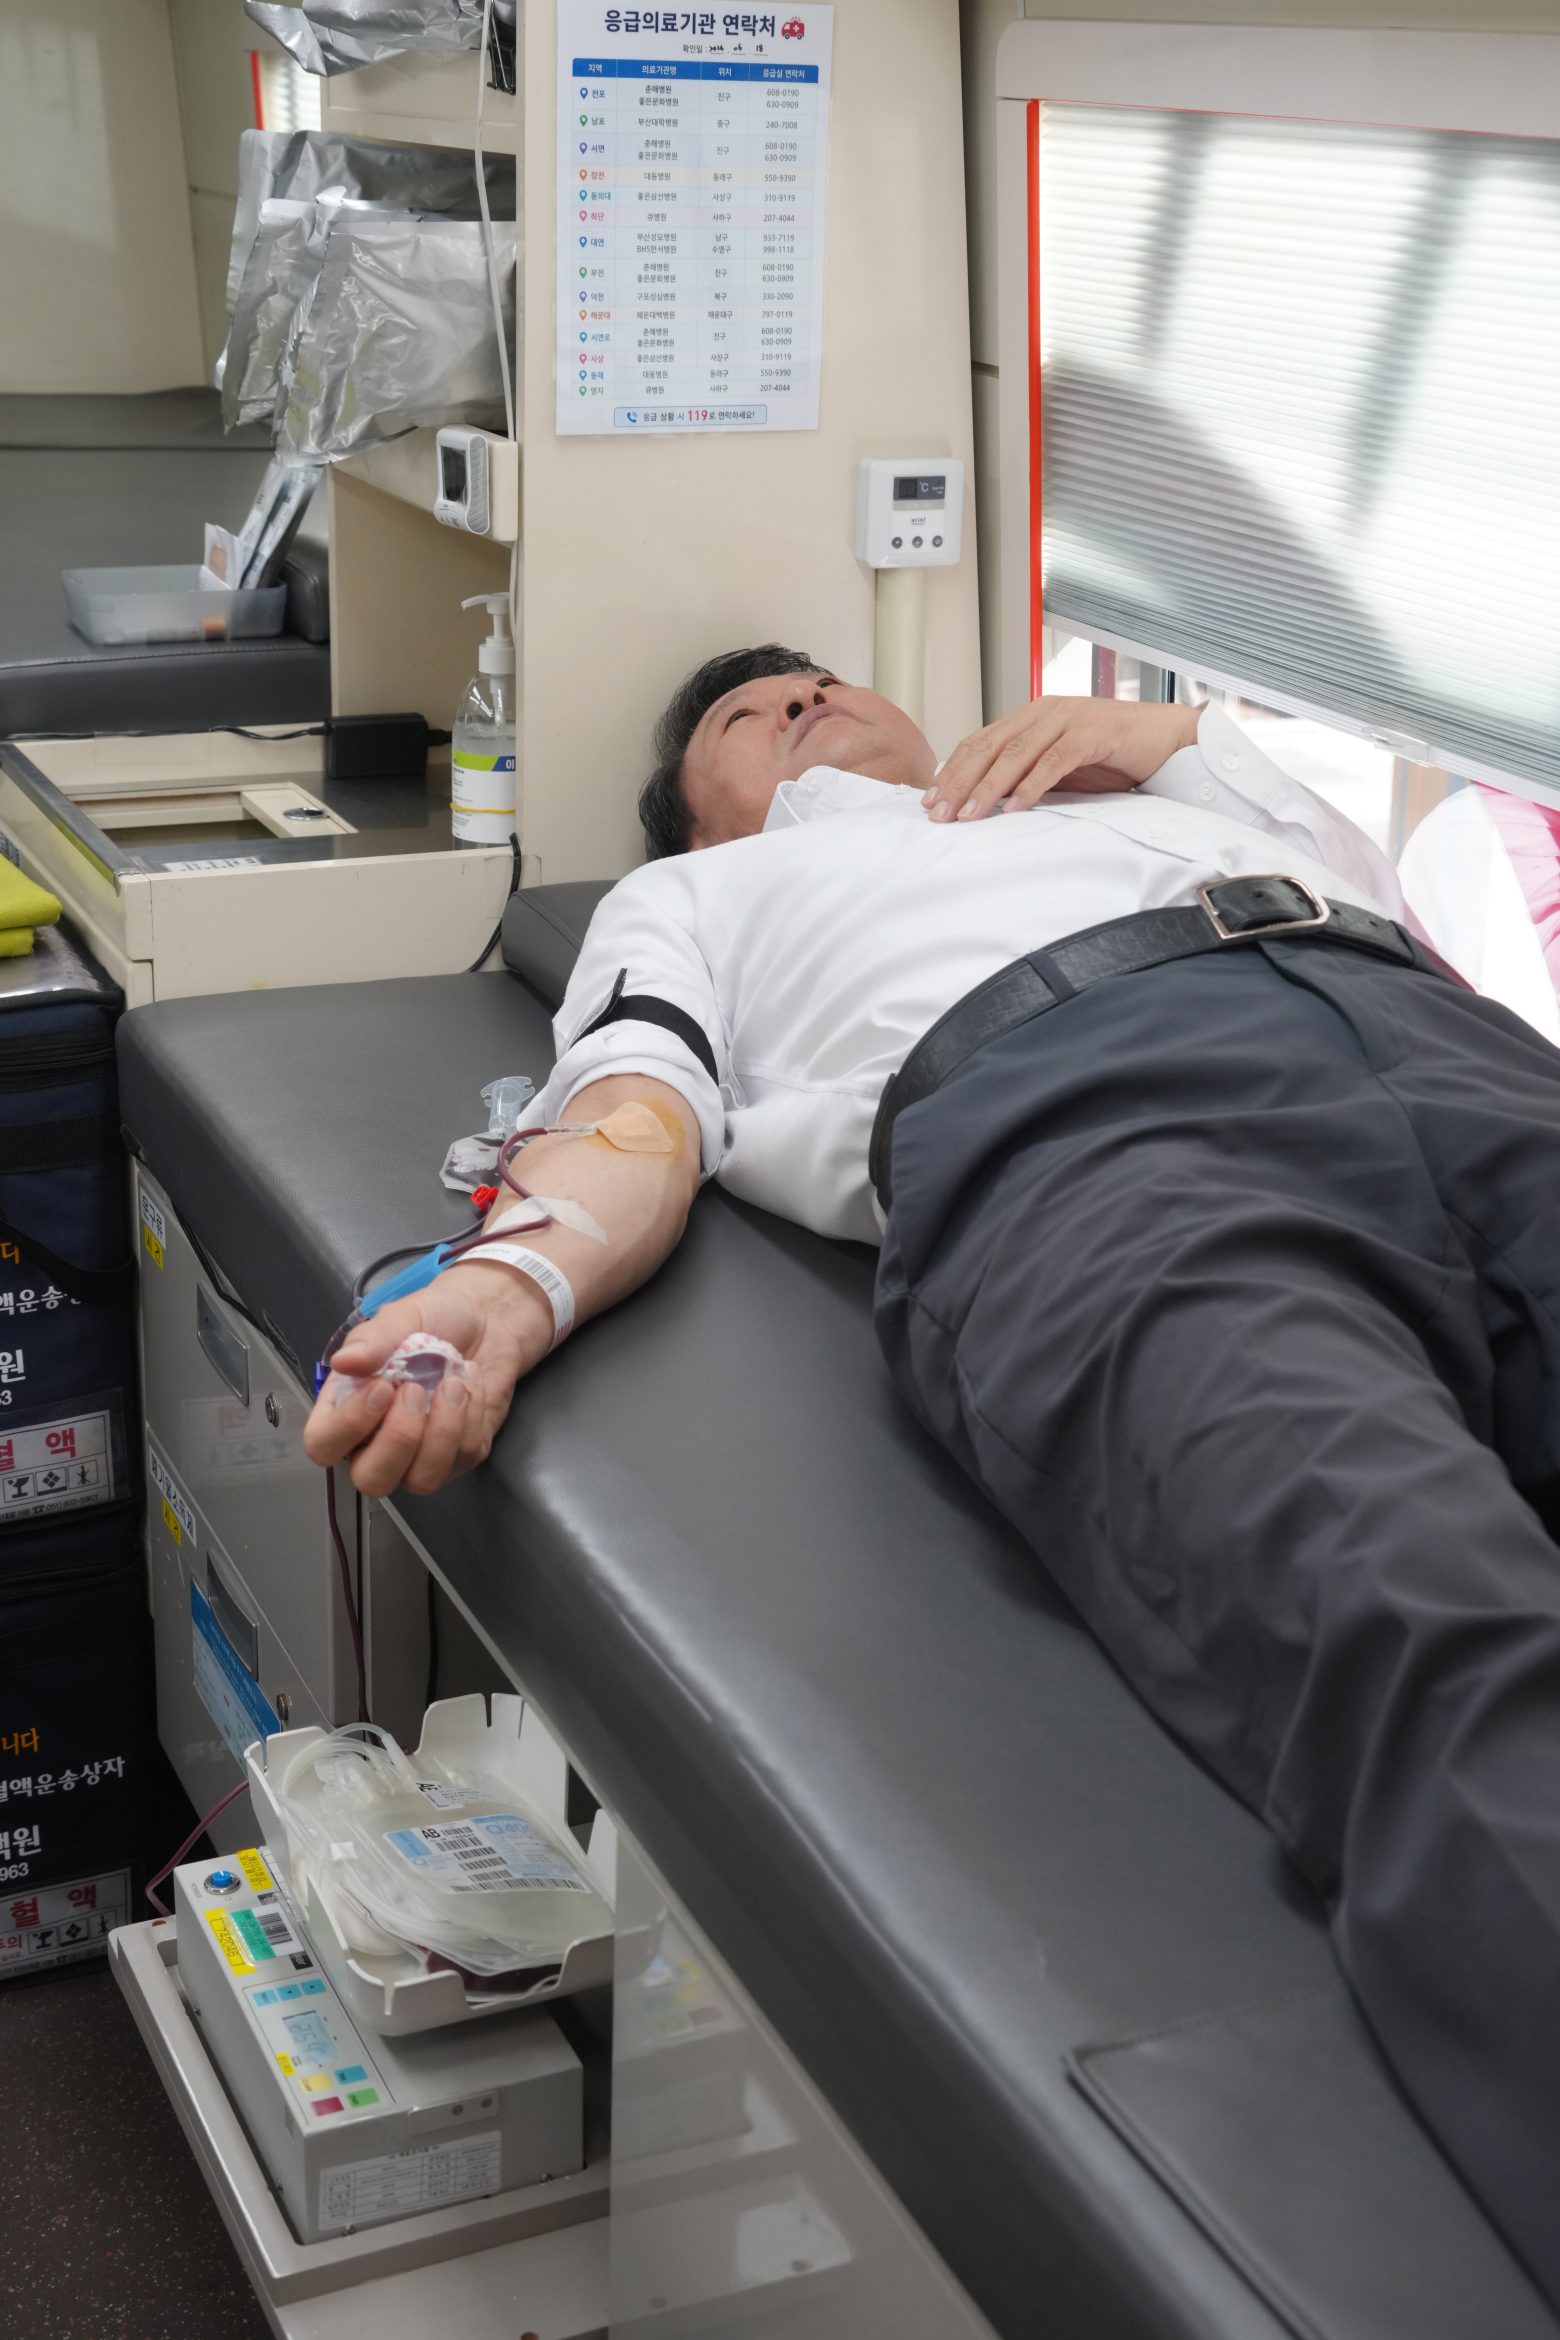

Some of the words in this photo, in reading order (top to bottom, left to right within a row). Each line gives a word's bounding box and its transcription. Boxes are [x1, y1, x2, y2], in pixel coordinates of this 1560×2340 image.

[604, 9, 716, 34] 응급의료기관
[723, 15, 775, 37] 연락처
[683, 45, 702, 54] 확인일
[588, 64, 602, 73] 지역
[642, 66, 676, 75] 의료기관명
[718, 67, 732, 76] 위치
[763, 67, 782, 79] 응급실
[785, 69, 805, 79] 연락처
[592, 90, 605, 99] 전포
[718, 92, 730, 101] 진구
[645, 85, 671, 94] 춘해병원
[767, 89, 799, 97] 608-0190
[638, 97, 679, 107] 좋은문화병원
[766, 101, 799, 109] 630-0909
[592, 117, 605, 126] 남포
[638, 118, 678, 128] 부산대학병원
[717, 120, 730, 128] 중구
[765, 121, 798, 129] 240-7008
[591, 144, 605, 153] 서면
[717, 147, 729, 155] 진구
[645, 140, 670, 149] 춘해병원
[765, 142, 797, 150] 608-0190
[765, 154, 796, 162] 630-0909
[591, 171, 604, 180] 장전
[644, 172, 670, 181] 대동병원
[764, 174, 795, 182] 550-9390
[591, 192, 611, 201] 동의대
[712, 193, 732, 202] 사상구
[764, 194, 795, 202] 310-9119
[591, 212, 604, 221] 하단
[647, 213, 667, 222] 큐병원
[712, 213, 731, 222] 사하구
[591, 238, 604, 246] 대연
[715, 234, 728, 242] 남구
[763, 234, 795, 242] 933-7119
[637, 245, 677, 254] BHS한서병원
[712, 245, 731, 254] 수영구
[763, 246, 794, 254] 998-1118
[591, 269, 604, 277] 부전
[715, 269, 727, 277] 진구
[762, 275, 794, 283] 630-0909
[591, 292, 604, 302] 덕천
[762, 293, 794, 301] 330-2090
[591, 311, 611, 319] 해운대
[762, 310, 793, 319] 797-0119
[761, 327, 792, 335] 608-0190
[591, 333, 610, 341] 서면로
[714, 332, 726, 341] 진구
[761, 338, 792, 346] 630-0909
[591, 355, 604, 363] 사상
[710, 353, 729, 362] 사상구
[761, 353, 792, 361] 310-9119
[643, 370, 668, 378] 대동병원
[709, 385, 728, 393] 사하구
[643, 412, 657, 422] 응급
[660, 412, 675, 422] 상황
[677, 412, 684, 421] 시
[718, 411, 755, 421] 연락하세요!
[0, 1285, 82, 1315] 액운송
[46, 1428, 76, 1458] 액
[422, 1828, 441, 1840] AB
[10, 1898, 40, 1928] 혈
[68, 1885, 97, 1909] 액
